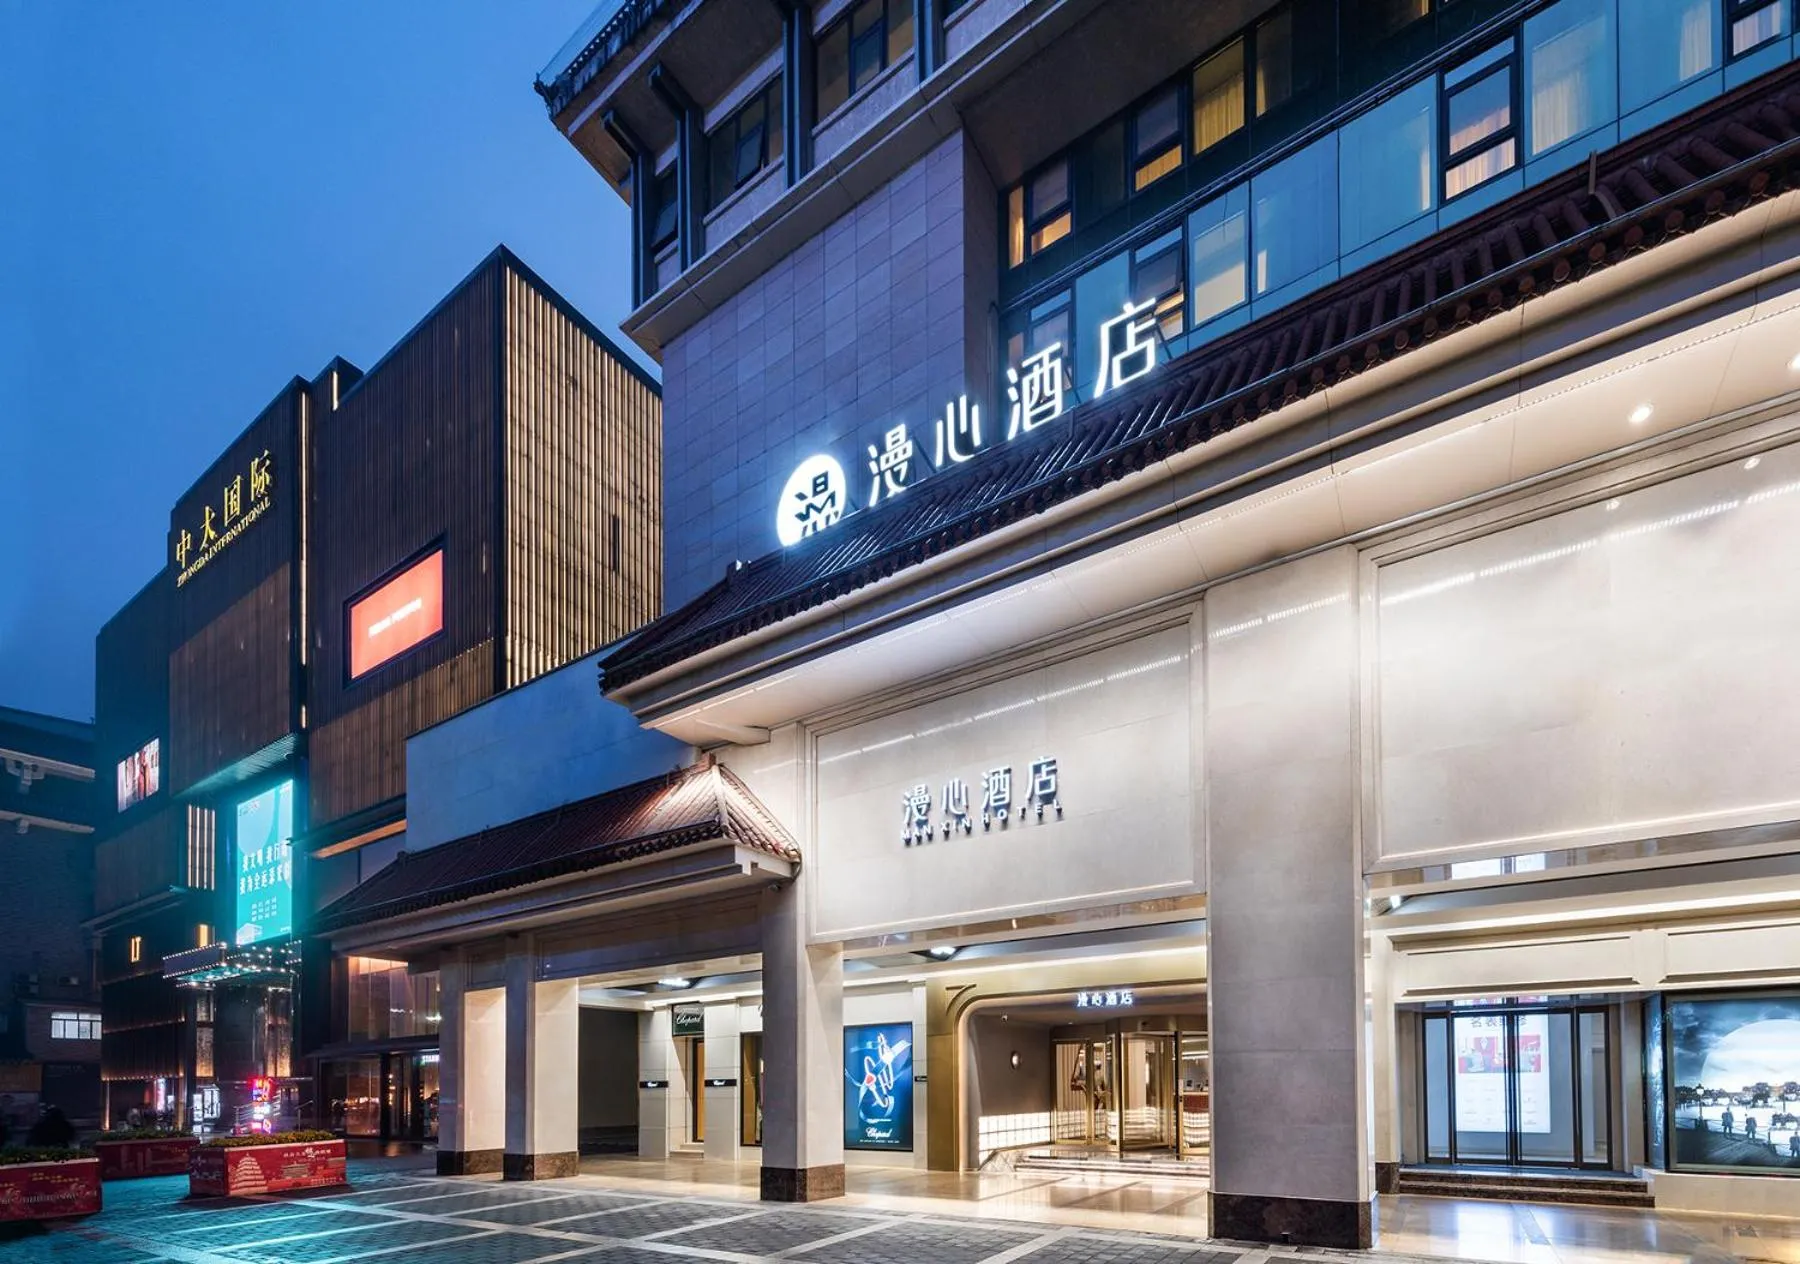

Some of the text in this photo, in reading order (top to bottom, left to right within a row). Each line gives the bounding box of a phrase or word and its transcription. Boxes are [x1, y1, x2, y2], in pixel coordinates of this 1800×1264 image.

[867, 297, 1158, 508] 漫心酒店
[176, 449, 272, 569] 中大国际
[208, 496, 271, 560] INTERNATIONAL
[902, 755, 1059, 825] 漫心酒店
[940, 816, 972, 833] XIN
[981, 799, 1064, 823] HOTEL
[676, 1011, 705, 1026] Chopard
